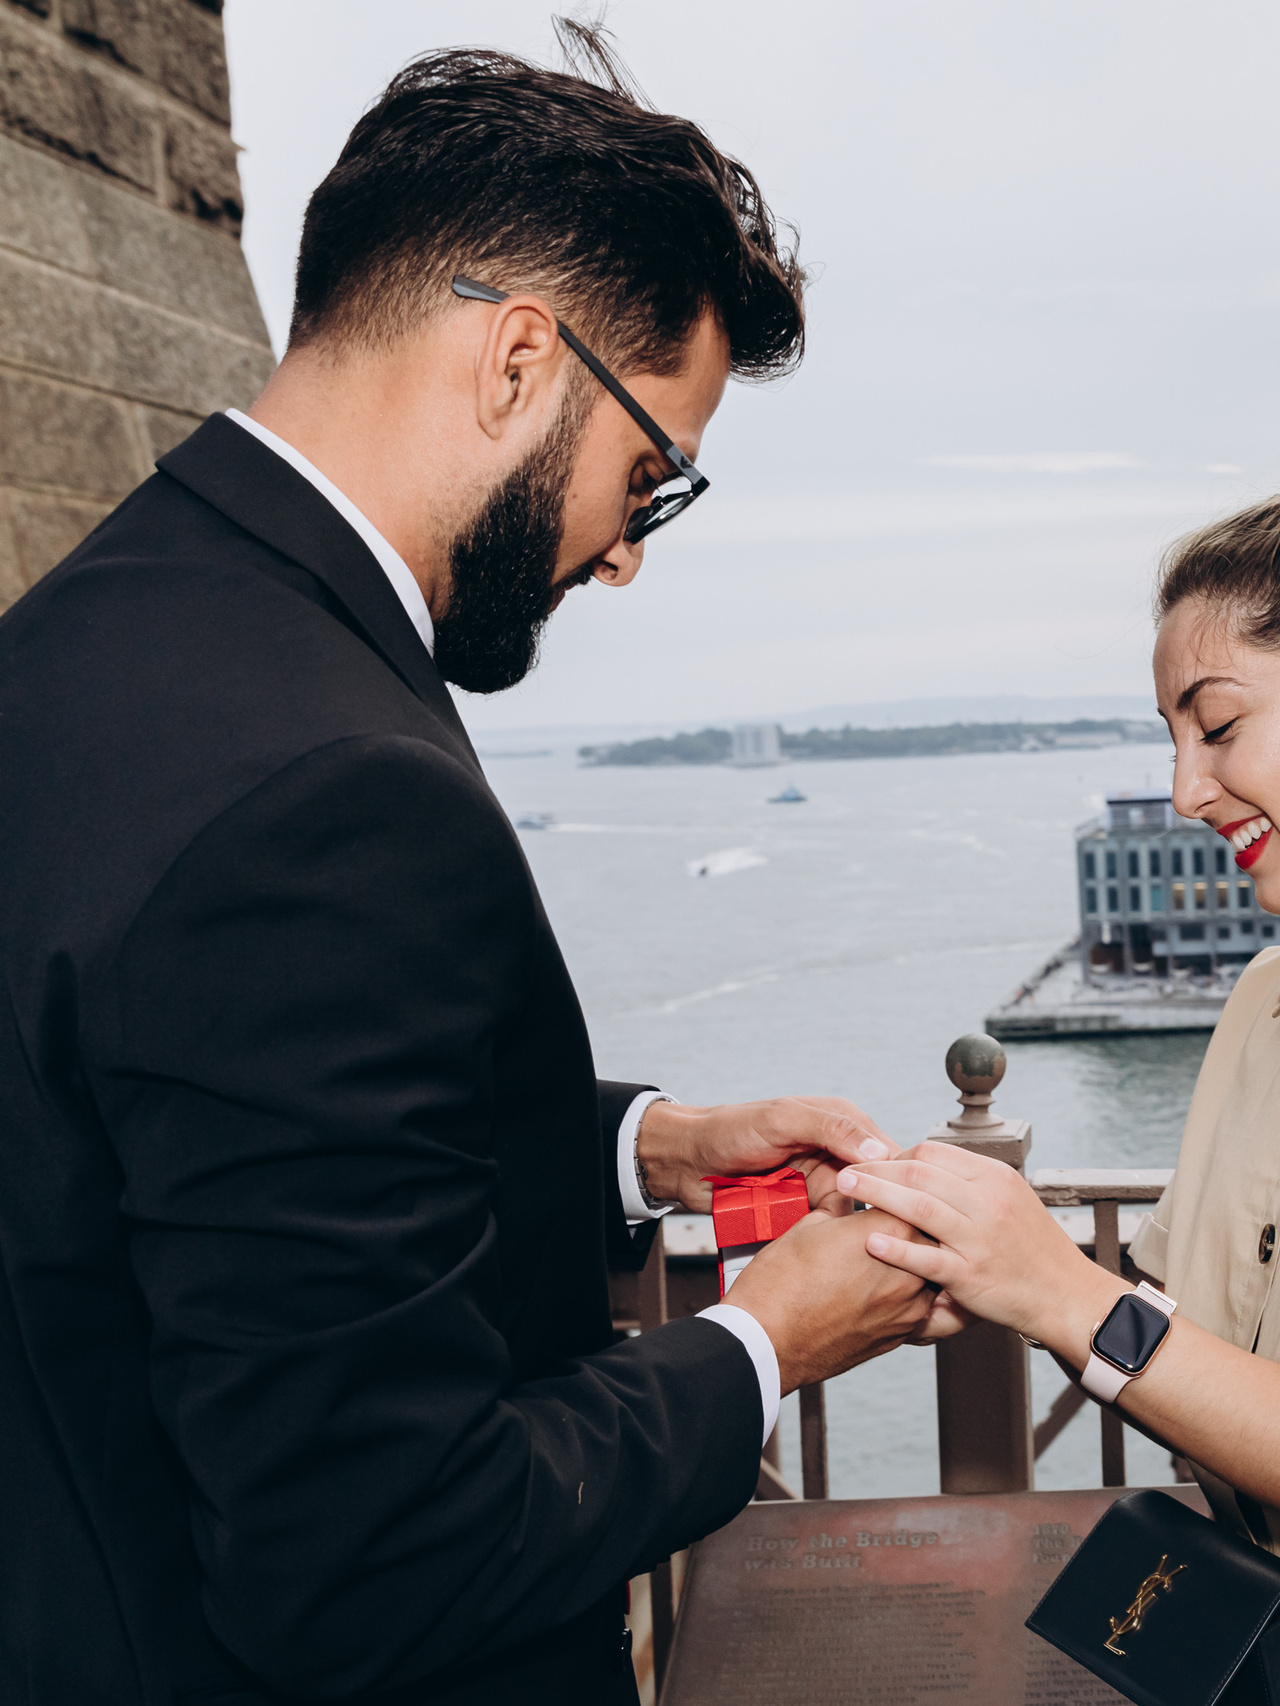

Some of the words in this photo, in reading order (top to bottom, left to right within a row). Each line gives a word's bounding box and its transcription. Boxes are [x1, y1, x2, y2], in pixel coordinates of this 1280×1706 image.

[749, 1534, 799, 1551] How
[809, 1532, 848, 1549] the
[856, 1529, 939, 1549] Bridge
[801, 1552, 863, 1571] Built
